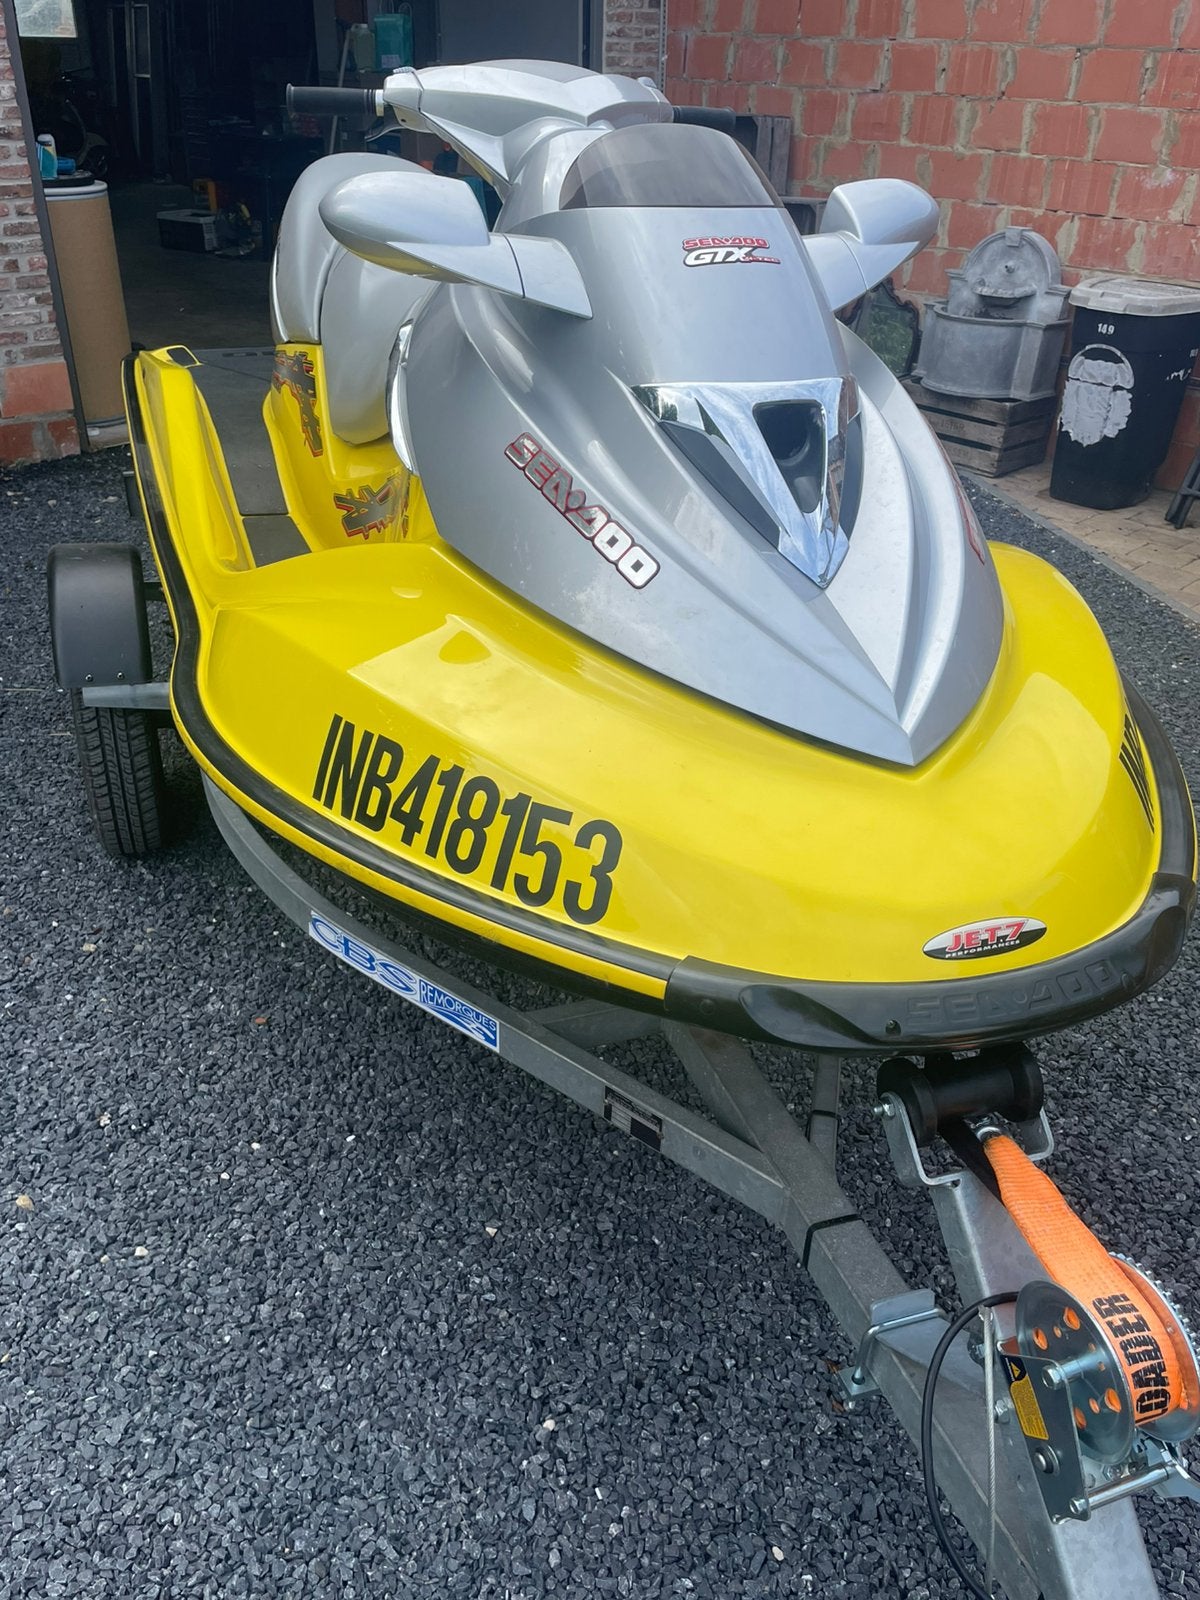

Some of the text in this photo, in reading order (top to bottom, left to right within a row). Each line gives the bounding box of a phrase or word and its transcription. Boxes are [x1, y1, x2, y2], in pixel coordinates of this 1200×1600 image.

[685, 247, 754, 265] GTX
[312, 713, 623, 925] INB418153
[313, 917, 497, 1032] CBS REMORQUES
[945, 940, 1020, 958] PERFORMANCES
